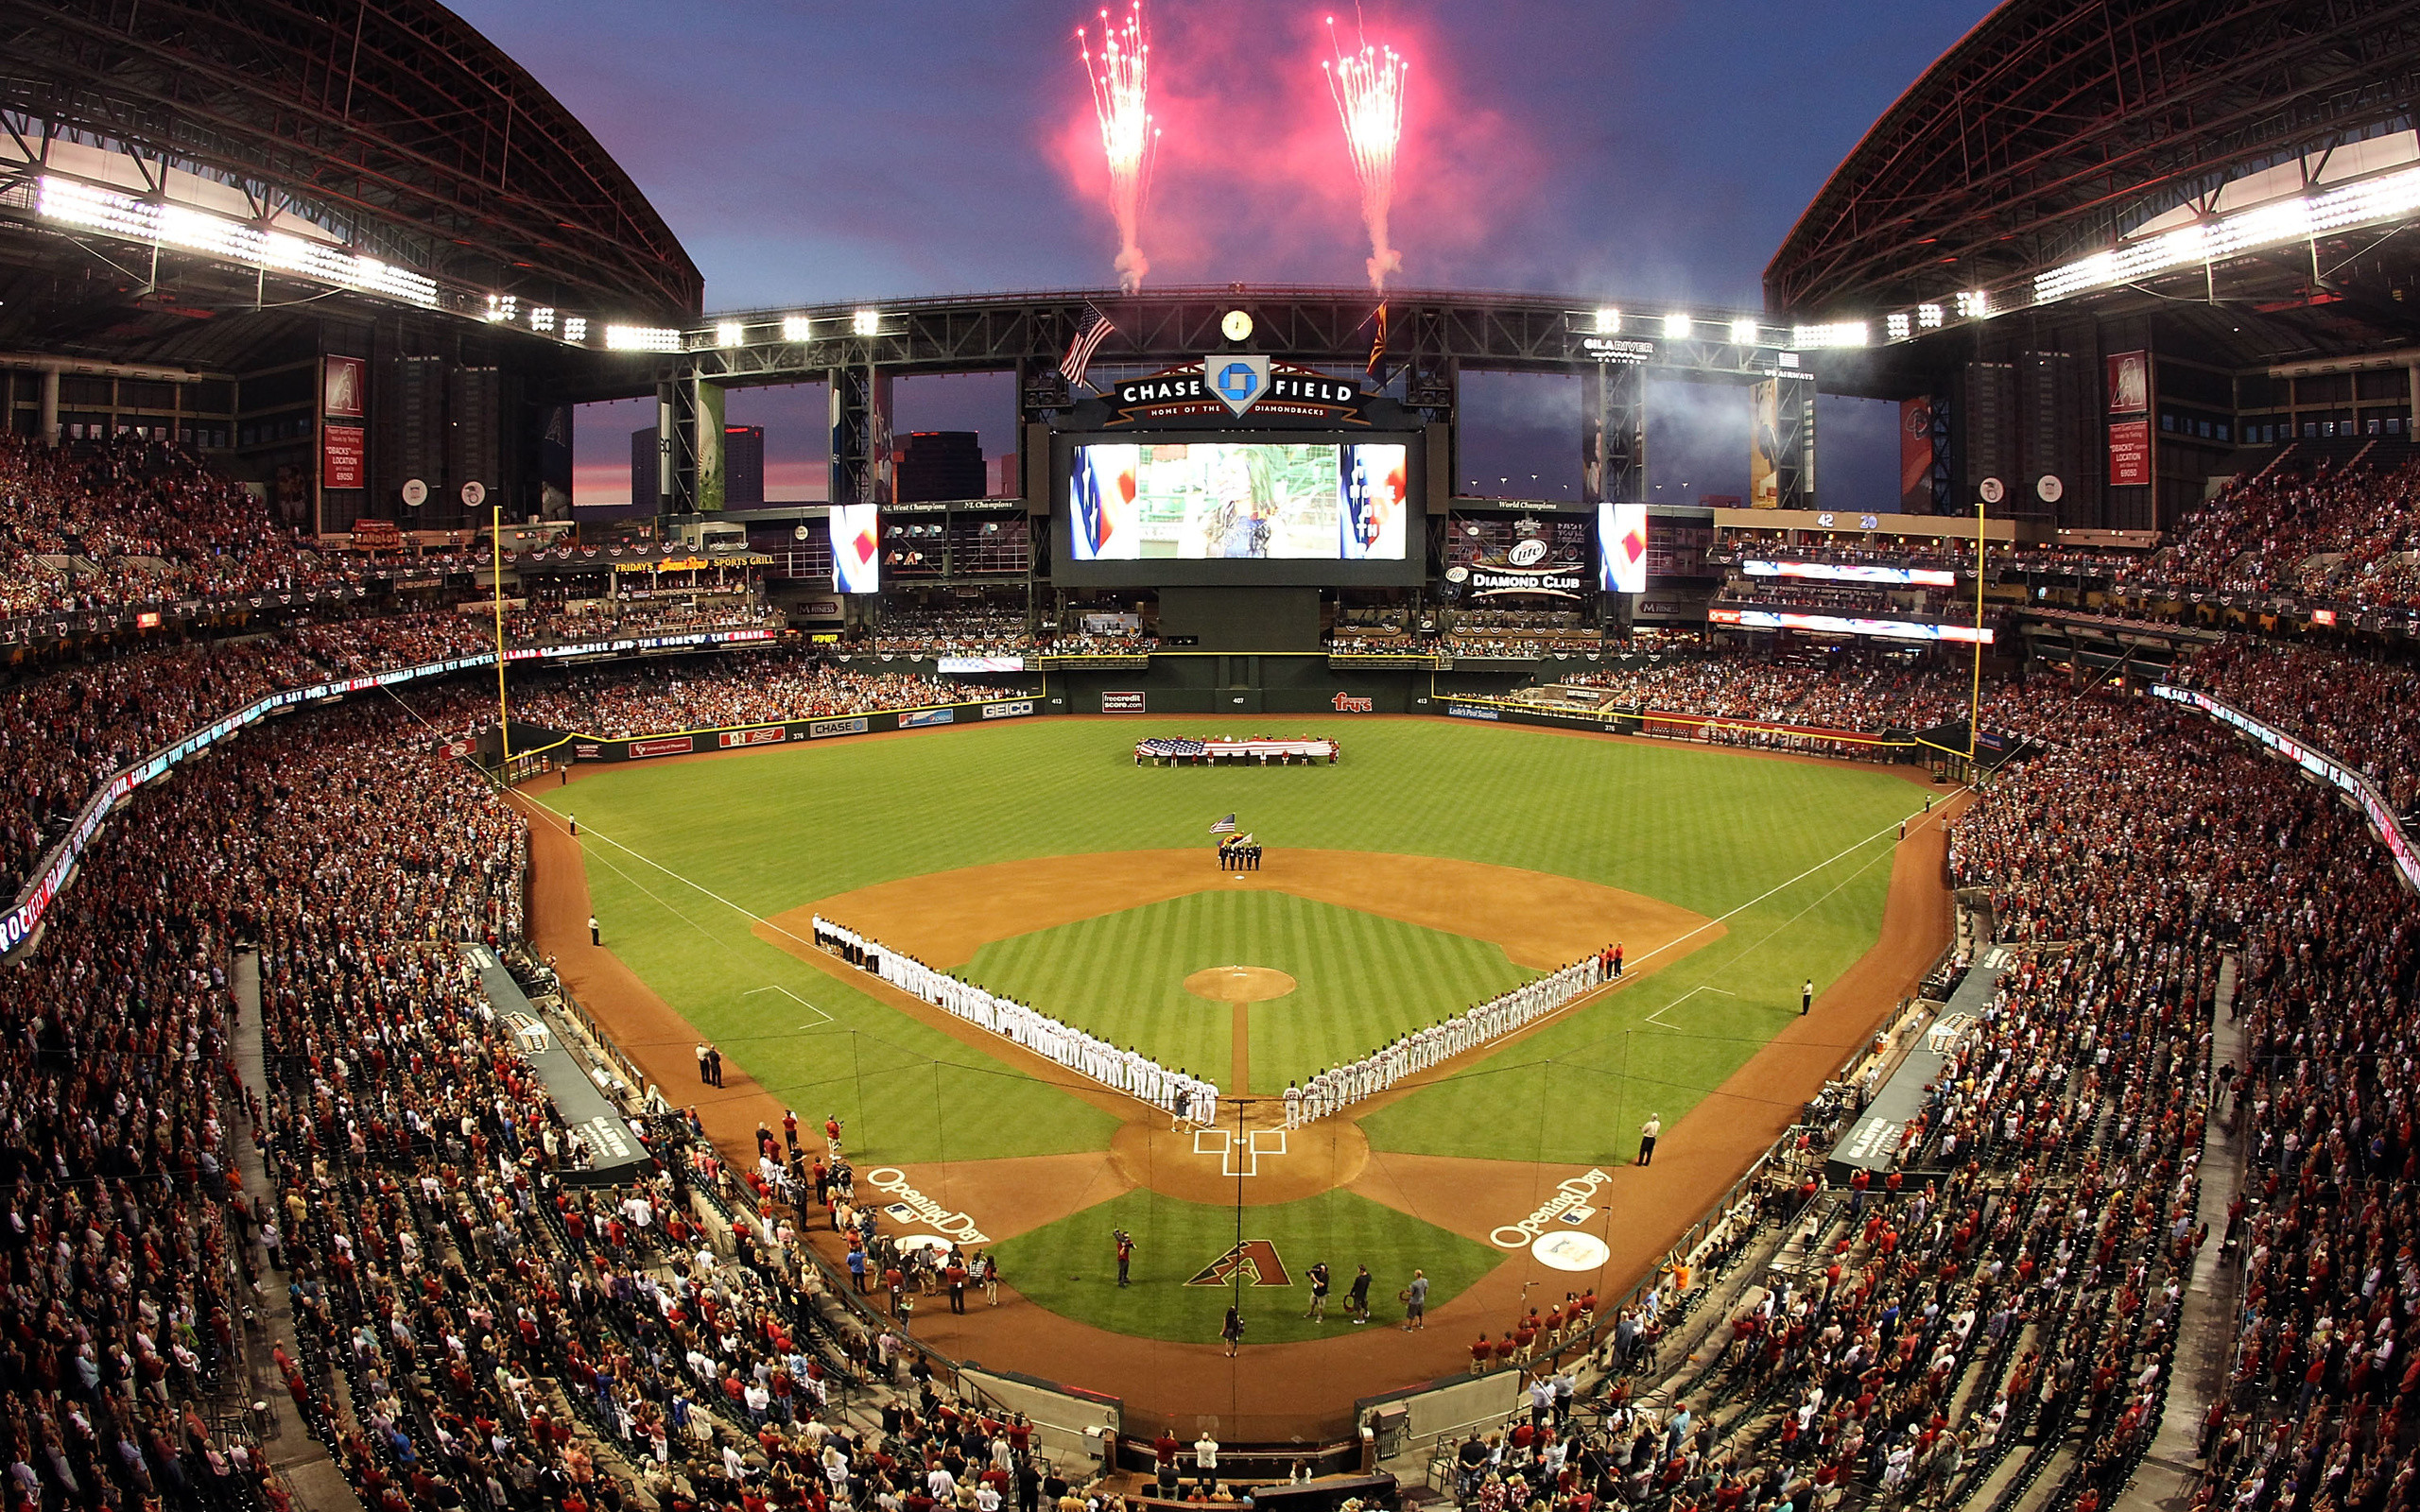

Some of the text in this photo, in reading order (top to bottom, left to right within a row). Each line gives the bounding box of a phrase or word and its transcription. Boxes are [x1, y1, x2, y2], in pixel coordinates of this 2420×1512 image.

[1614, 341, 1653, 353] RIVER
[1764, 369, 1814, 381] US AIRWAYS
[1123, 381, 1201, 403] CHASE
[1275, 380, 1352, 402] FIELD
[1150, 407, 1178, 417] HOME
[1254, 405, 1324, 416] DIAMONDBACKS
[332, 456, 358, 465] LOCATION
[2116, 452, 2141, 462] LOCATION
[909, 503, 946, 512] Champions
[975, 501, 1012, 510] Champions
[1520, 502, 1557, 510] Champions
[1818, 513, 1877, 529] 42 20
[1517, 547, 1540, 562] Lite
[615, 562, 654, 573] FRIDAY'S
[713, 558, 747, 567] SPORTS
[750, 556, 774, 565] GRILL
[1473, 574, 1581, 589] DIAMOND CLUB
[285, 691, 302, 703] SAY
[330, 679, 352, 696] THAT
[353, 677, 374, 691] STAR
[445, 661, 458, 671] YET
[509, 647, 537, 660] LAND
[540, 645, 553, 657] OF
[582, 641, 609, 653] FREE
[612, 640, 634, 651] AND
[638, 637, 658, 648] THE
[662, 635, 691, 646] HOME
[710, 632, 731, 643] THE
[733, 629, 769, 641] BRAVE.
[1233, 696, 1244, 705] 407
[1332, 691, 1373, 713] fry's
[983, 701, 1033, 717] GEICO
[1449, 707, 1499, 720] Leslie's Pool Supplies
[934, 713, 952, 723] pepsi
[815, 722, 852, 734] CHASE
[646, 745, 666, 753] University
[867, 1167, 991, 1246] Opening Day
[1490, 1167, 1613, 1248] Opening Day
